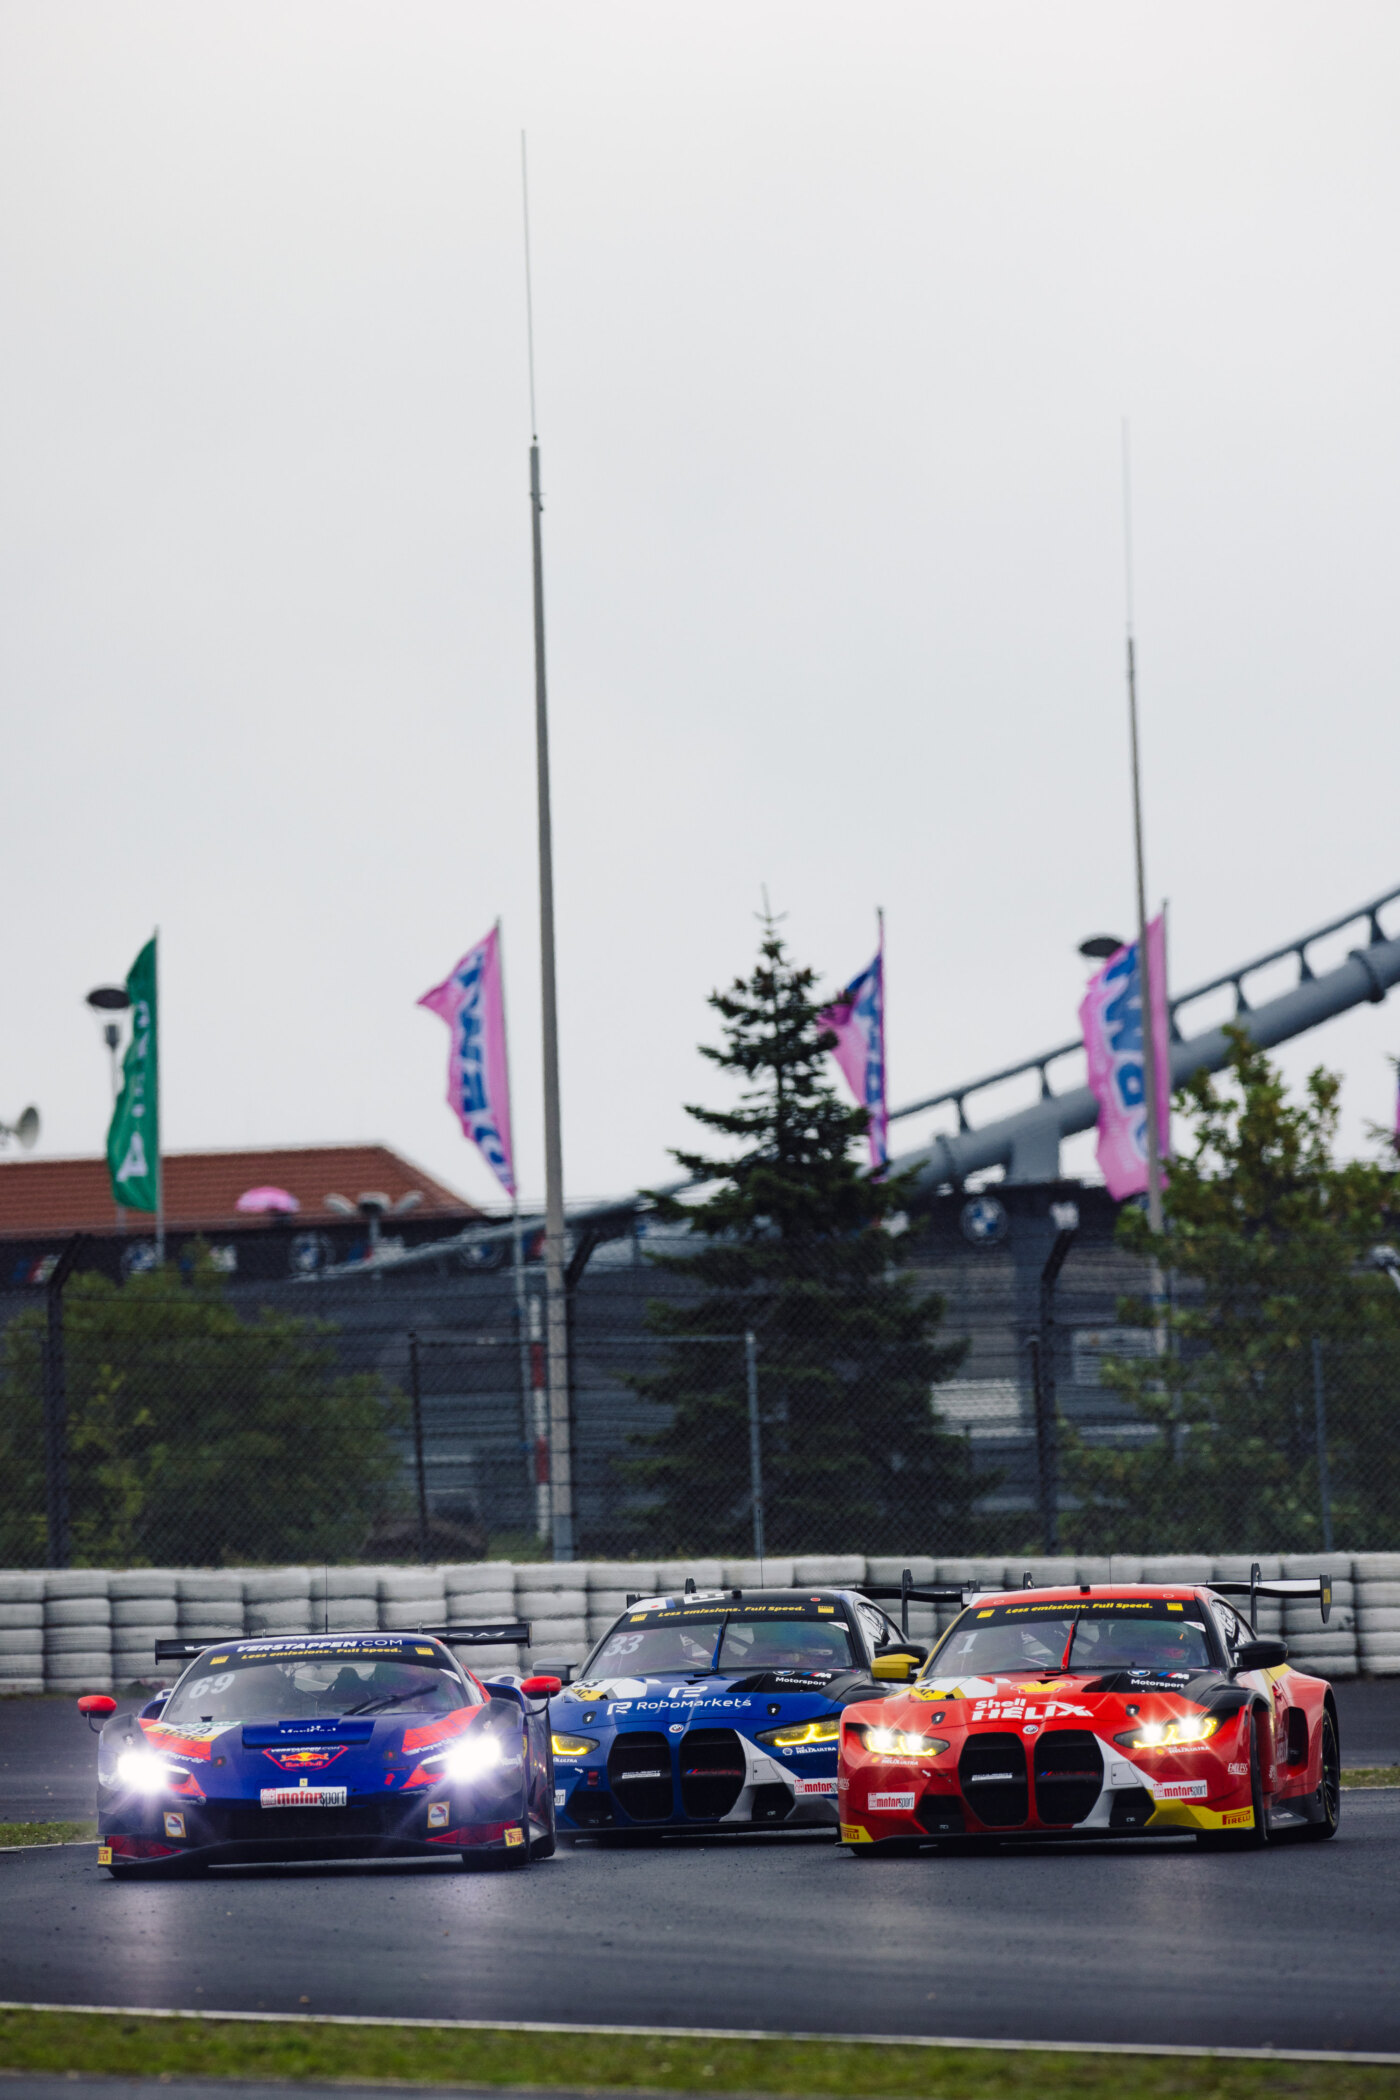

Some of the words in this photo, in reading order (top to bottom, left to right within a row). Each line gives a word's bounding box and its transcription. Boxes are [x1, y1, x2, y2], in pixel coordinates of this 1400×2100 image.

[683, 1607, 741, 1615] emissions.
[1031, 1603, 1089, 1611] emissions.
[237, 1640, 403, 1653] VERSTAPPEN.COM
[602, 1634, 645, 1657] 33
[957, 1632, 978, 1654] 1
[269, 1648, 333, 1657] emissions.
[189, 1673, 235, 1699] 69
[775, 1676, 827, 1686] Motorsport
[1131, 1678, 1185, 1688] Motorsport
[636, 1698, 752, 1711] RoboMarkets
[975, 1698, 1027, 1710] Shell
[971, 1701, 1095, 1721] HELIX
[1164, 1783, 1206, 1797] motorsport
[277, 1791, 346, 1807] motorsport
[876, 1796, 914, 1808] motorsport
